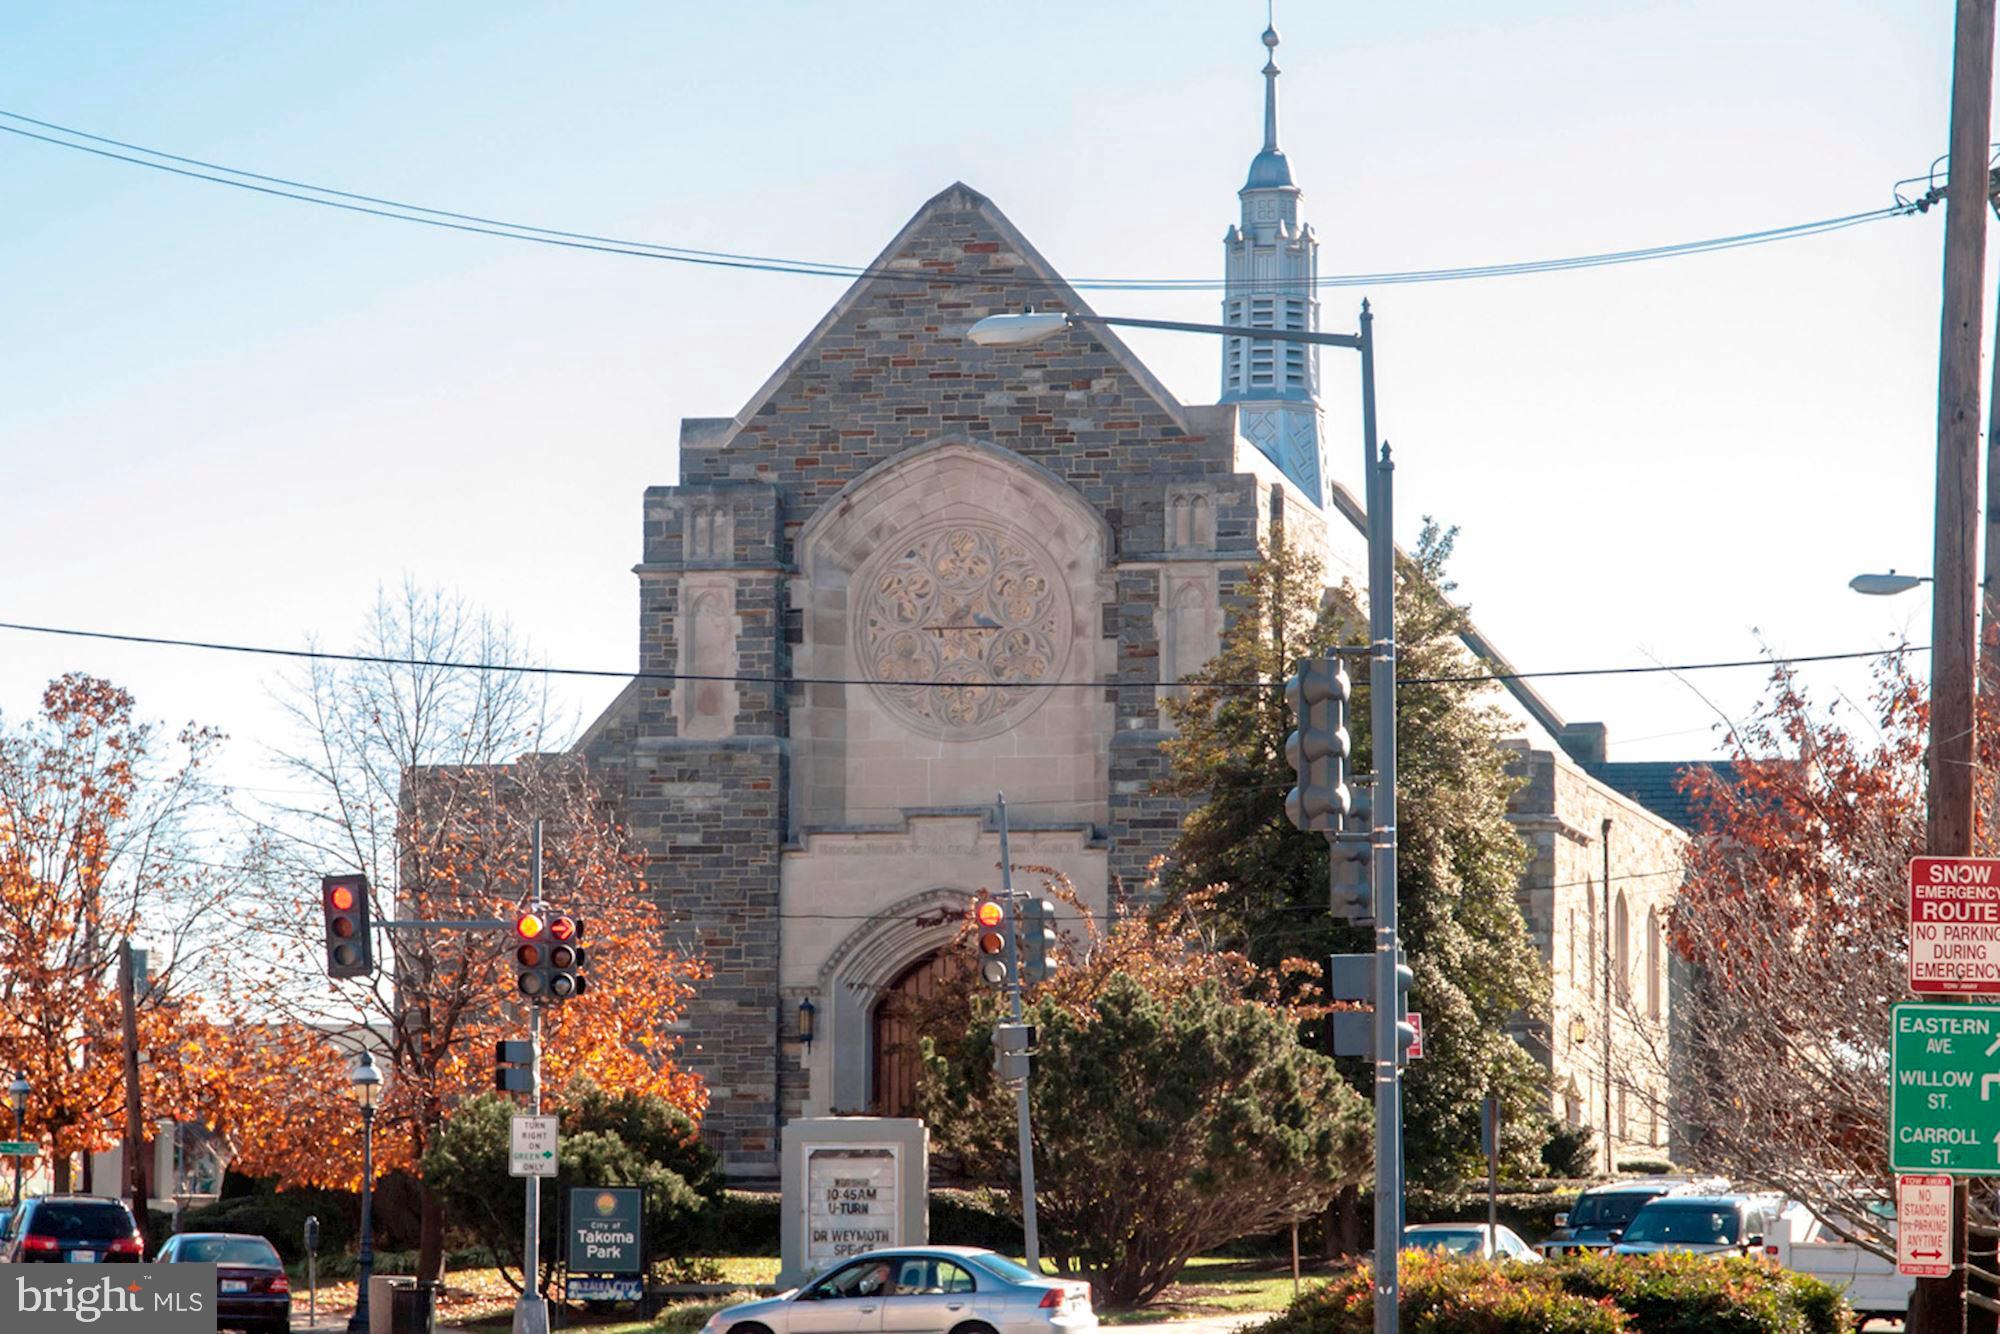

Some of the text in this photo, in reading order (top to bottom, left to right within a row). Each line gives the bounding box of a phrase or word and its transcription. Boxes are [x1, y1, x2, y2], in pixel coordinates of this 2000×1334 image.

[1930, 865, 1991, 884] SNOW
[1922, 902, 1998, 921] ROUTE
[1916, 925, 2000, 941] NO PARKING
[1934, 944, 1986, 959] DURING
[1900, 1017, 1990, 1035] EASTERN
[1926, 1038, 1955, 1054] AVE.
[1899, 1071, 1973, 1087] WILLOW
[1927, 1094, 1951, 1110] ST.
[1899, 1127, 1981, 1145] CARROLL
[1930, 1149, 1954, 1165] ST.
[523, 1163, 544, 1171] ONLY
[1919, 1189, 1931, 1201] NO
[828, 1203, 869, 1214] U-TURN
[1904, 1203, 1946, 1216] STANDING
[590, 1222, 609, 1230] City
[1914, 1220, 1947, 1232] PARKING
[577, 1230, 634, 1243] Takoma
[813, 1231, 828, 1242] DR
[1907, 1235, 1943, 1247] ANYTIME
[586, 1245, 622, 1258] Park
